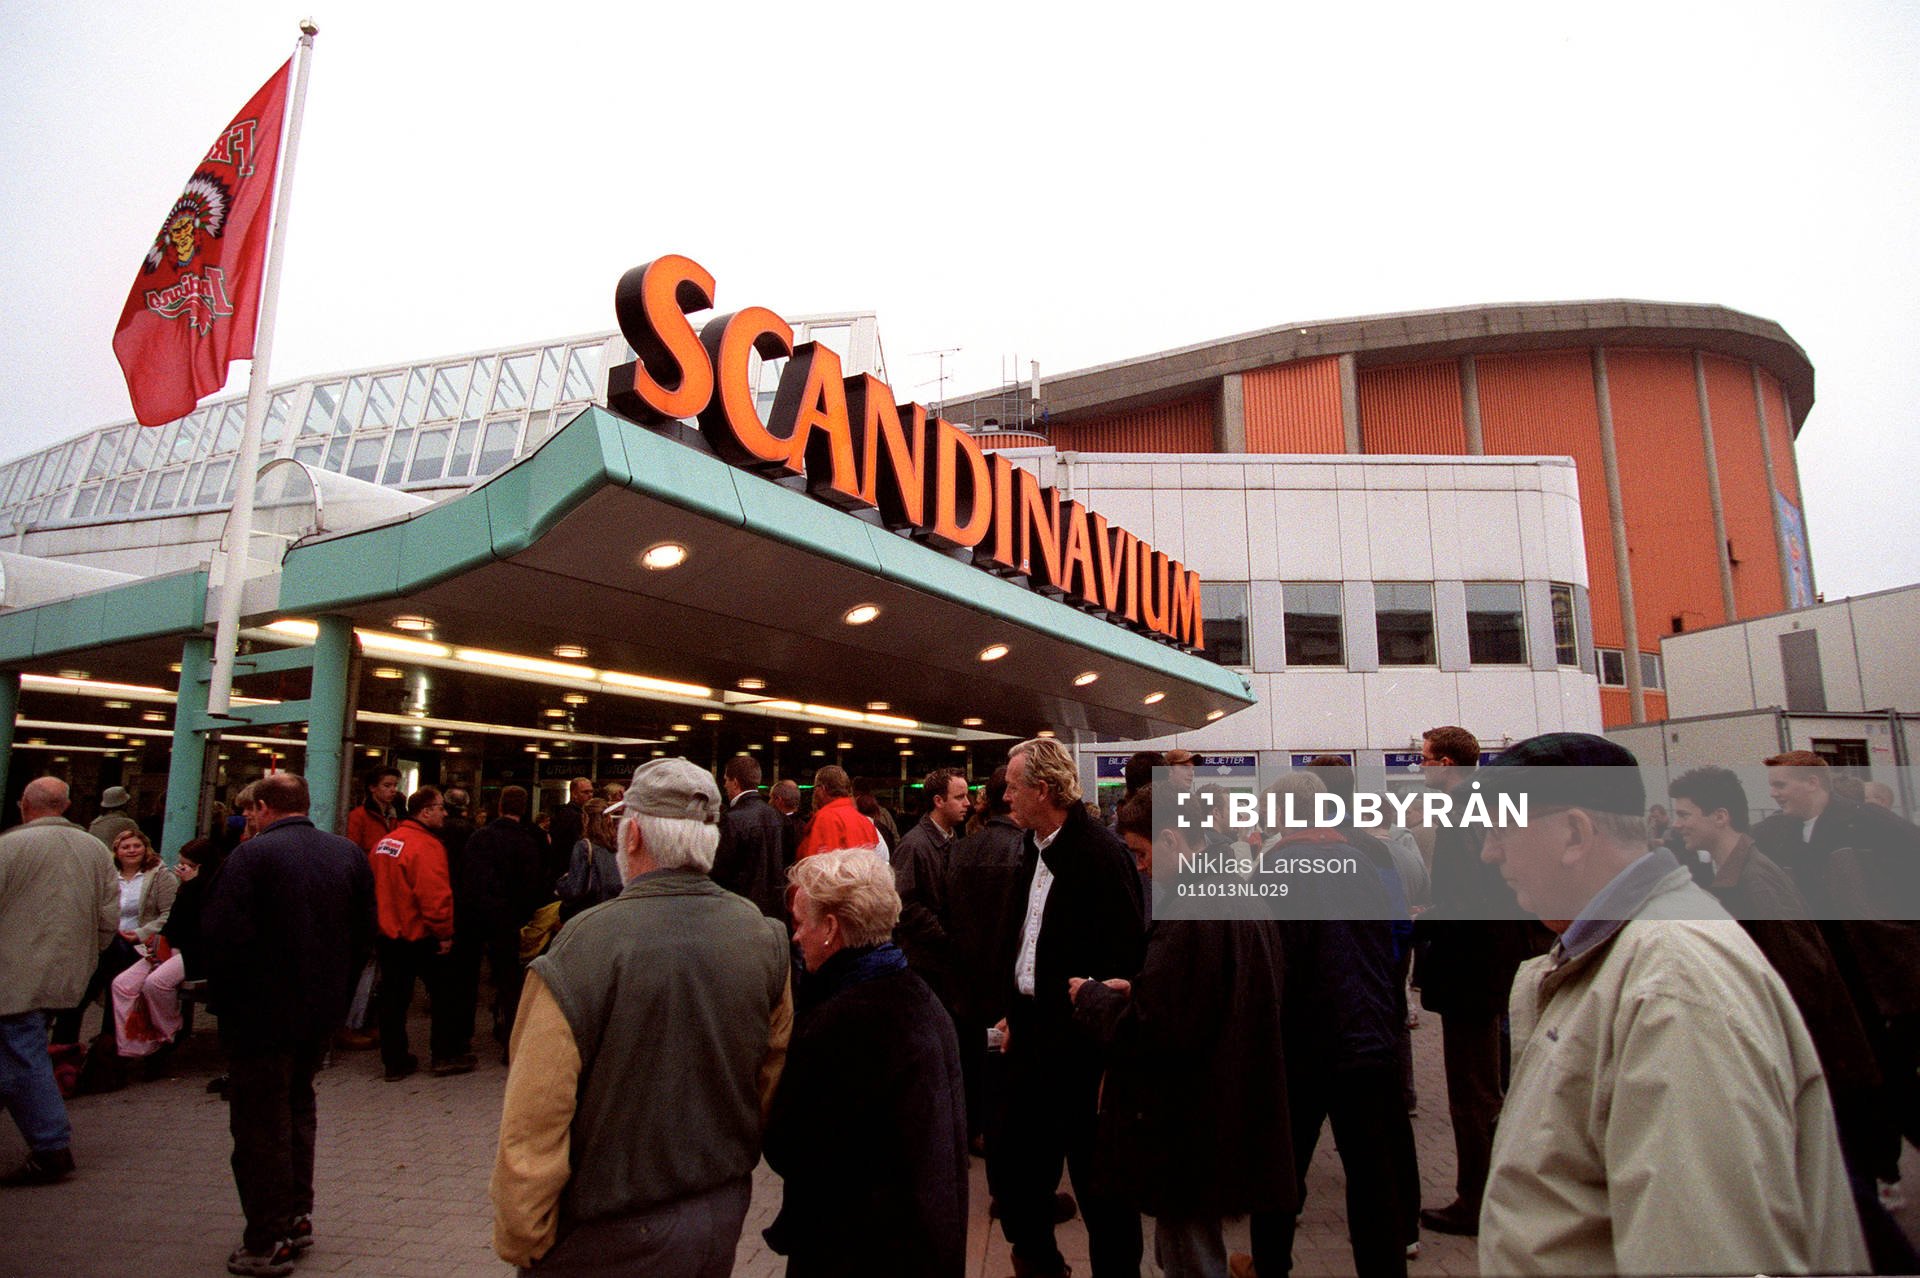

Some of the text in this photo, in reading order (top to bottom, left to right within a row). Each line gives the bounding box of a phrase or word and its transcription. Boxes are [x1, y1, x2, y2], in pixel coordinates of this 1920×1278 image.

[612, 253, 1205, 651] SCANDINAVIUM
[1108, 756, 1130, 765] BILJE
[1205, 756, 1245, 765] BILJETTER
